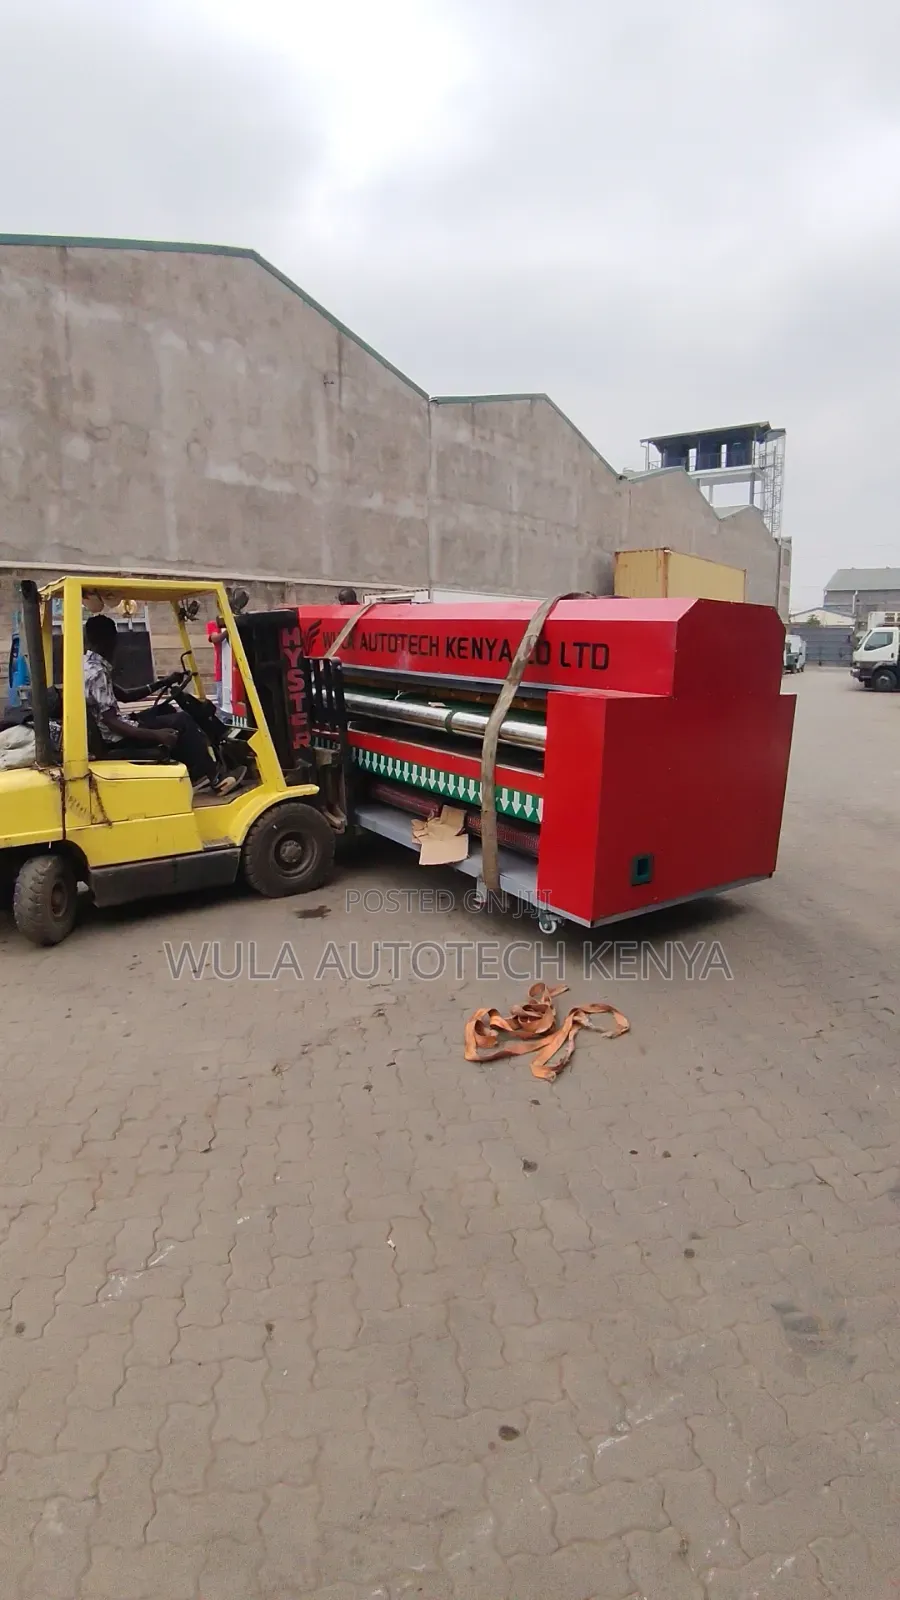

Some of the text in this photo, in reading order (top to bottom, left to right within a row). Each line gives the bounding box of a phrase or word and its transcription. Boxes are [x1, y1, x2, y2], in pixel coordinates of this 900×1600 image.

[281, 627, 311, 749] HYSTER
[360, 631, 440, 657] AUTOTECH
[445, 636, 513, 663] KENYA
[560, 641, 610, 670] LTD
